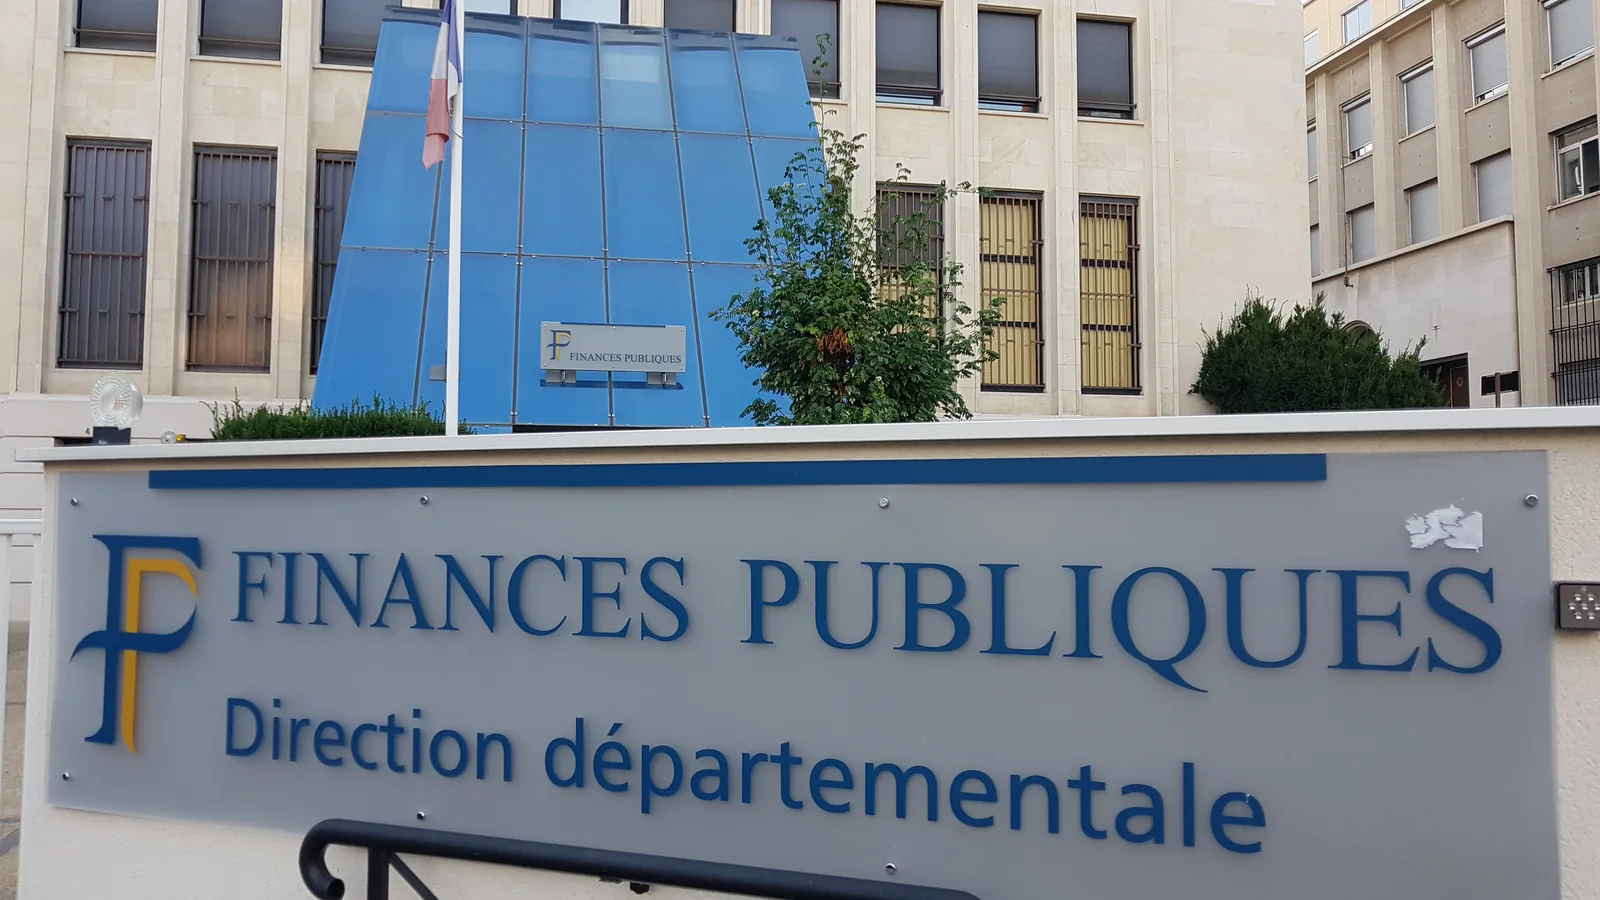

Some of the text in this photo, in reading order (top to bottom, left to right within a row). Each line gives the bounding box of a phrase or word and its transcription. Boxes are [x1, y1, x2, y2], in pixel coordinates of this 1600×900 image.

[569, 352, 682, 364] FINANCES PUBLIQUES
[231, 551, 1504, 692] FINANCES PUBLIQUES
[225, 697, 1267, 856] Direction départementale
